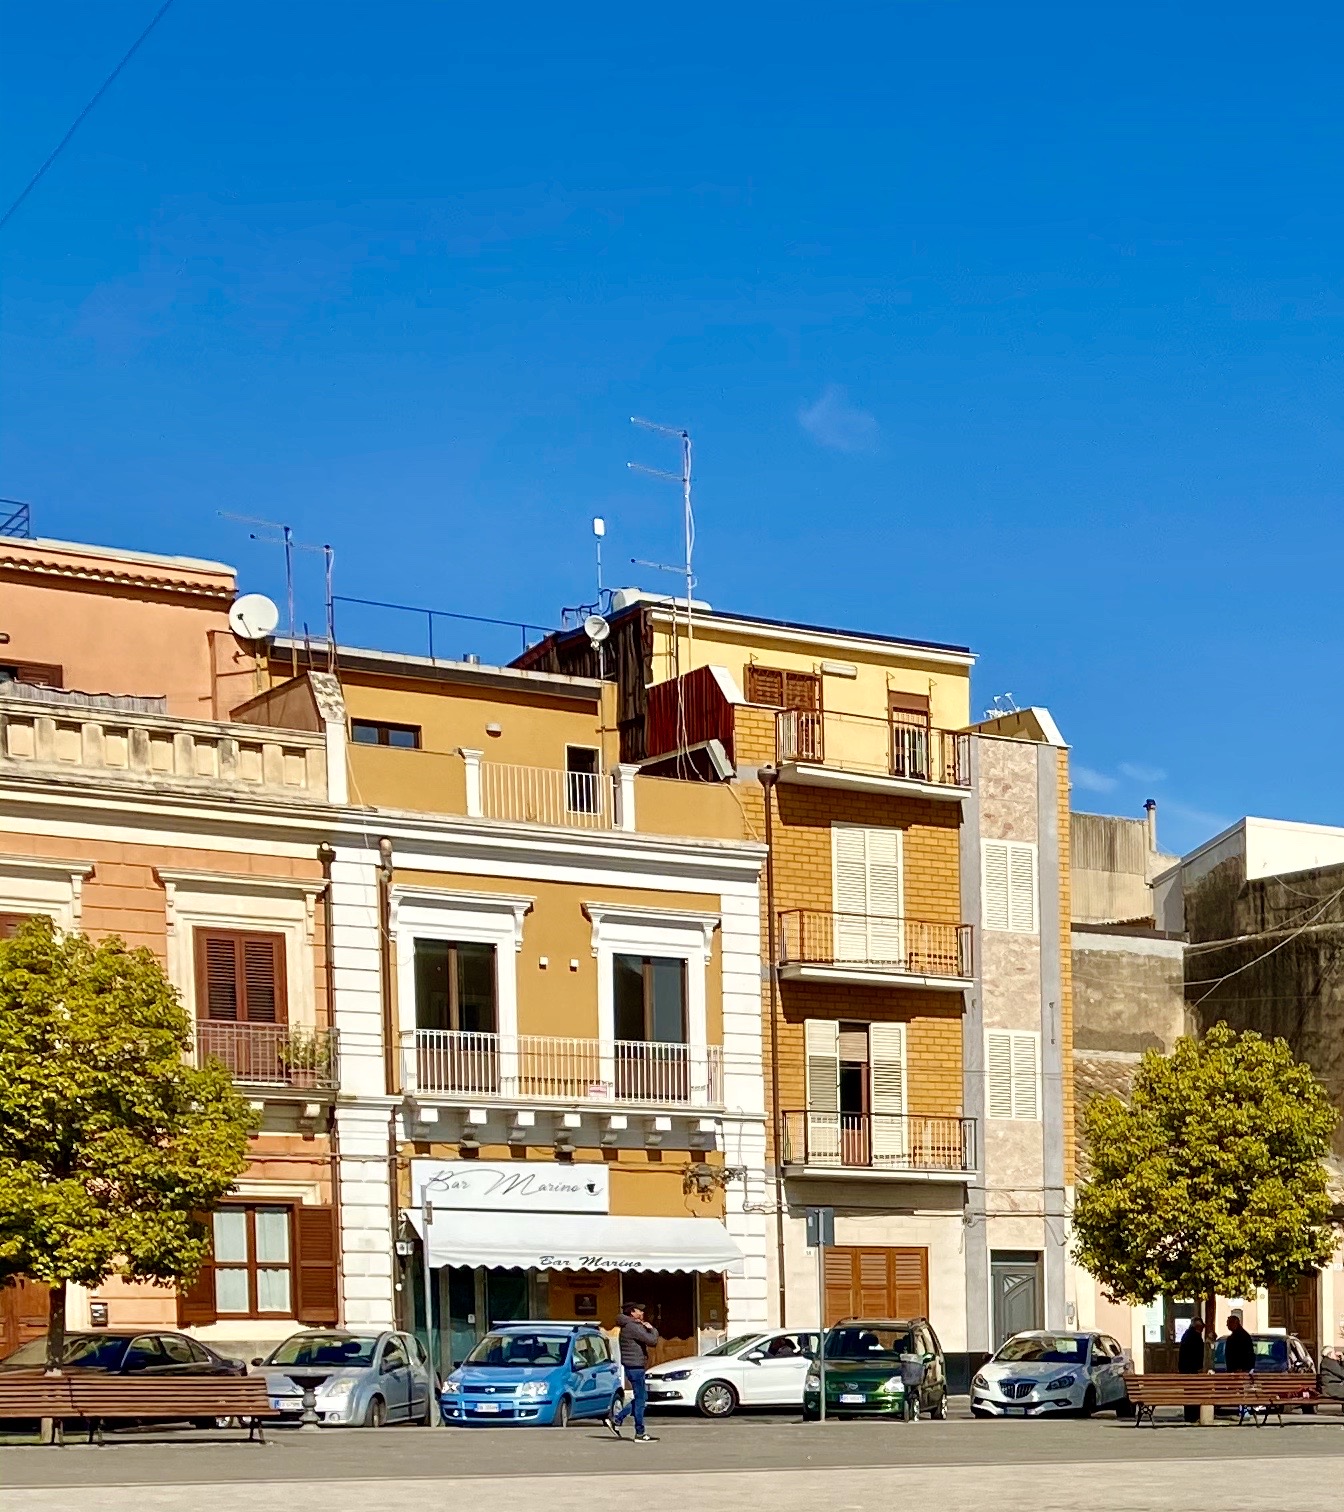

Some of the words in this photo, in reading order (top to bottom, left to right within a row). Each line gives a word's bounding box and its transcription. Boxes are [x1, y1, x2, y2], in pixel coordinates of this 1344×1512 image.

[426, 1170, 470, 1191] Bar
[453, 1168, 581, 1195] Marino
[539, 1255, 571, 1266] Bar
[579, 1256, 642, 1267] Marino
